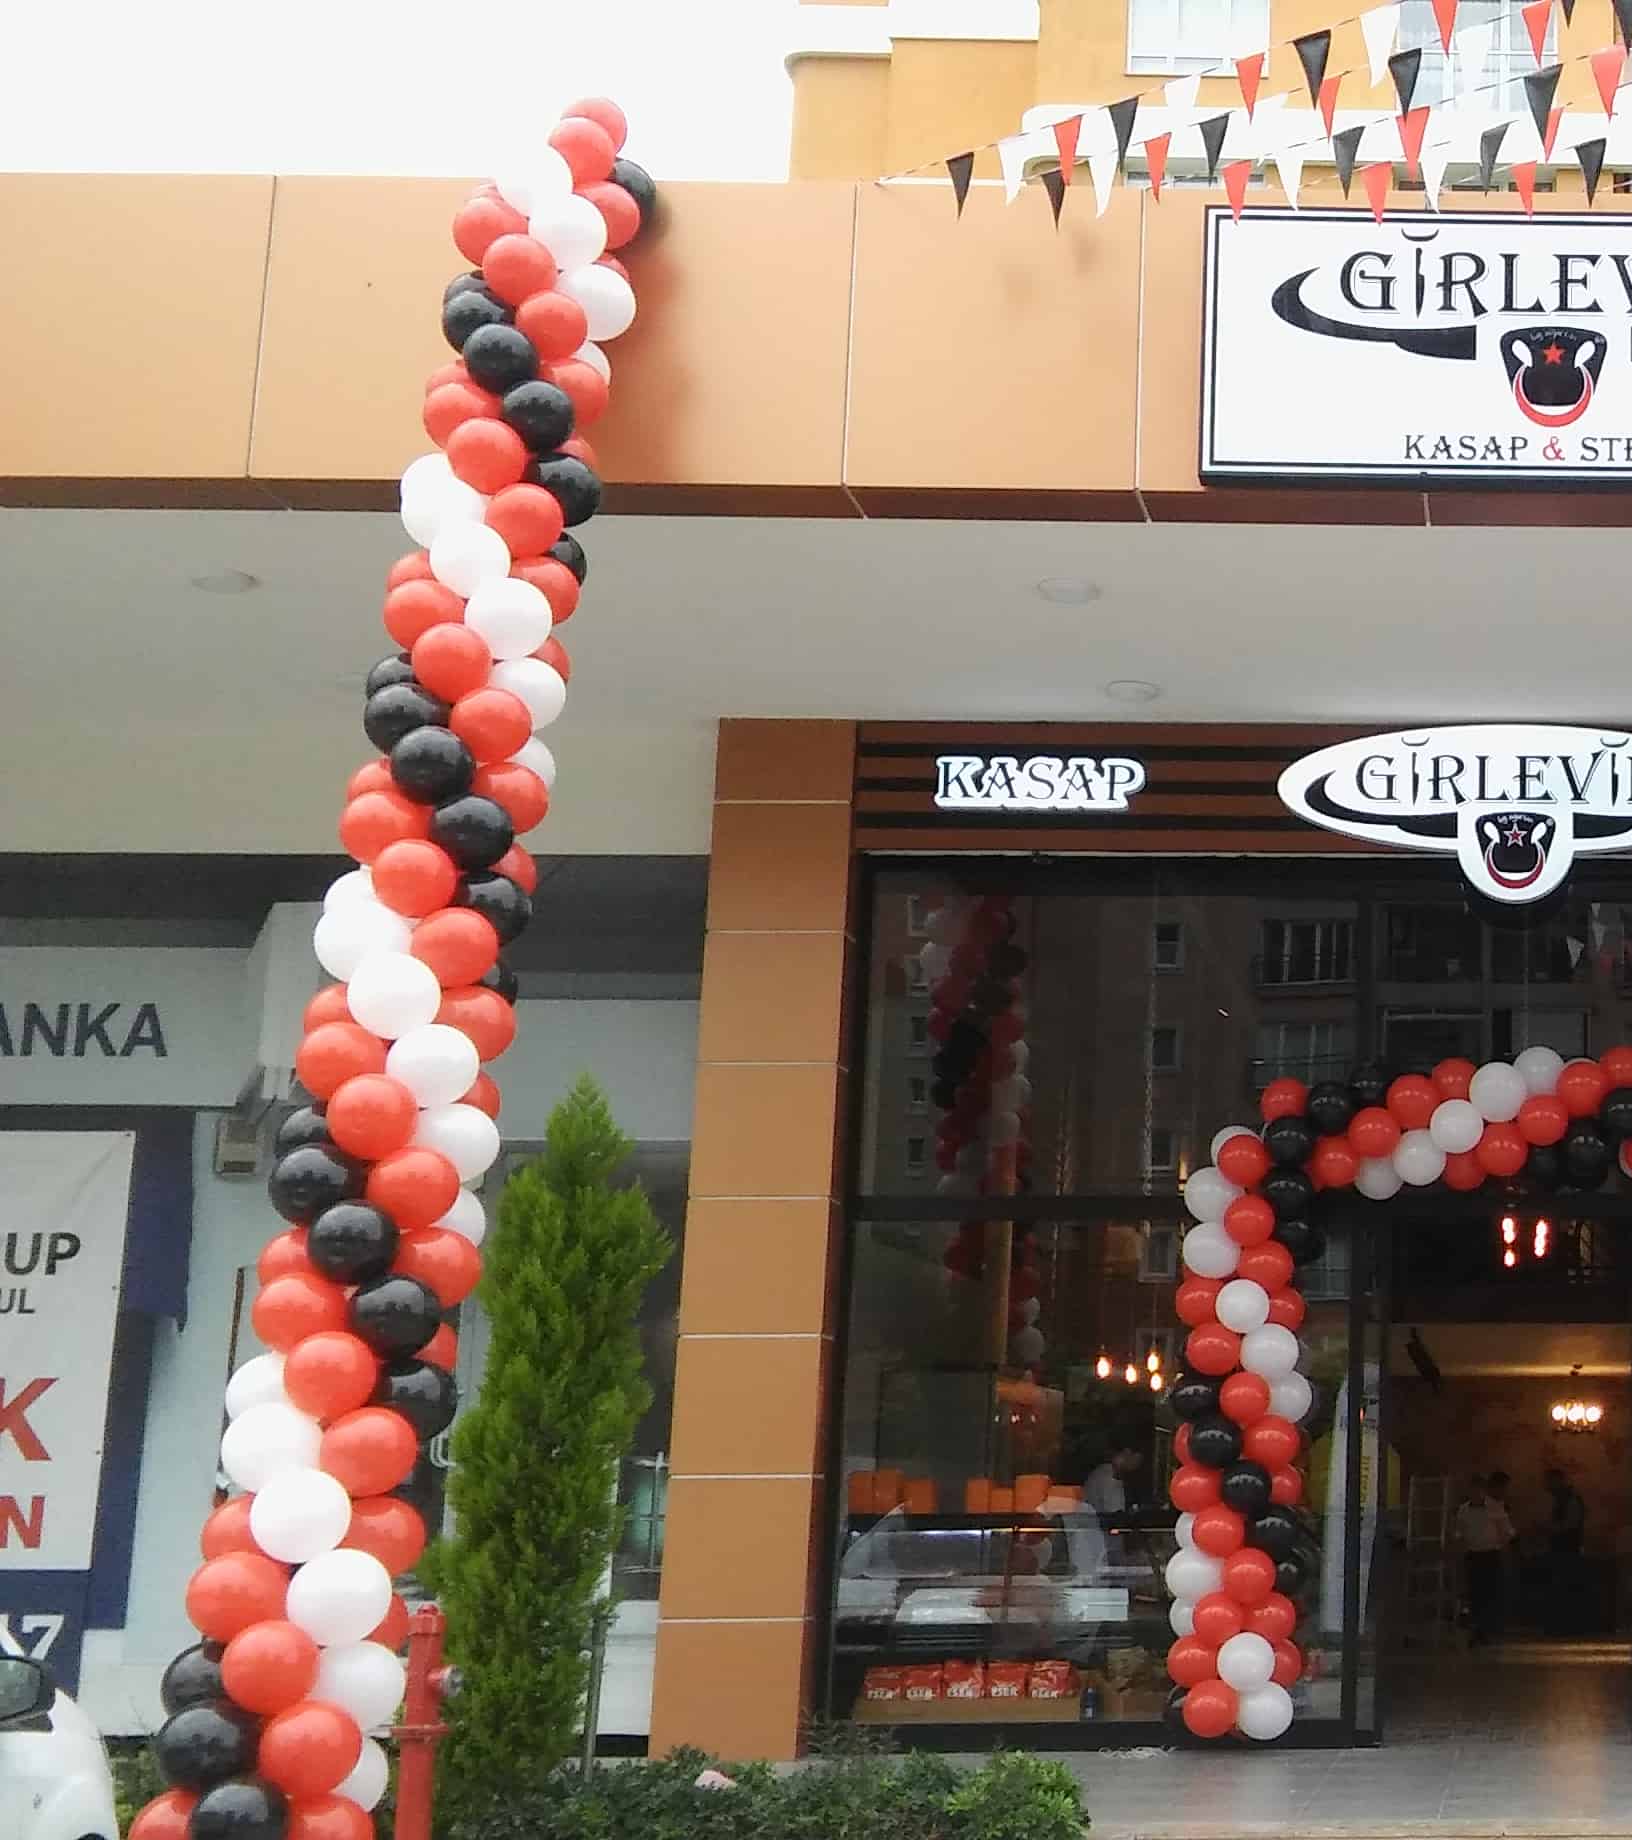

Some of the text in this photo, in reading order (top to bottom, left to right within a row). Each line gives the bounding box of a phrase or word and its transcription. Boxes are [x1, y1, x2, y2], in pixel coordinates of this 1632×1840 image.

[1404, 434, 1529, 461] KASAP
[1542, 436, 1566, 461] &
[938, 760, 1140, 803] KASAP
[0, 1002, 168, 1057] NKA
